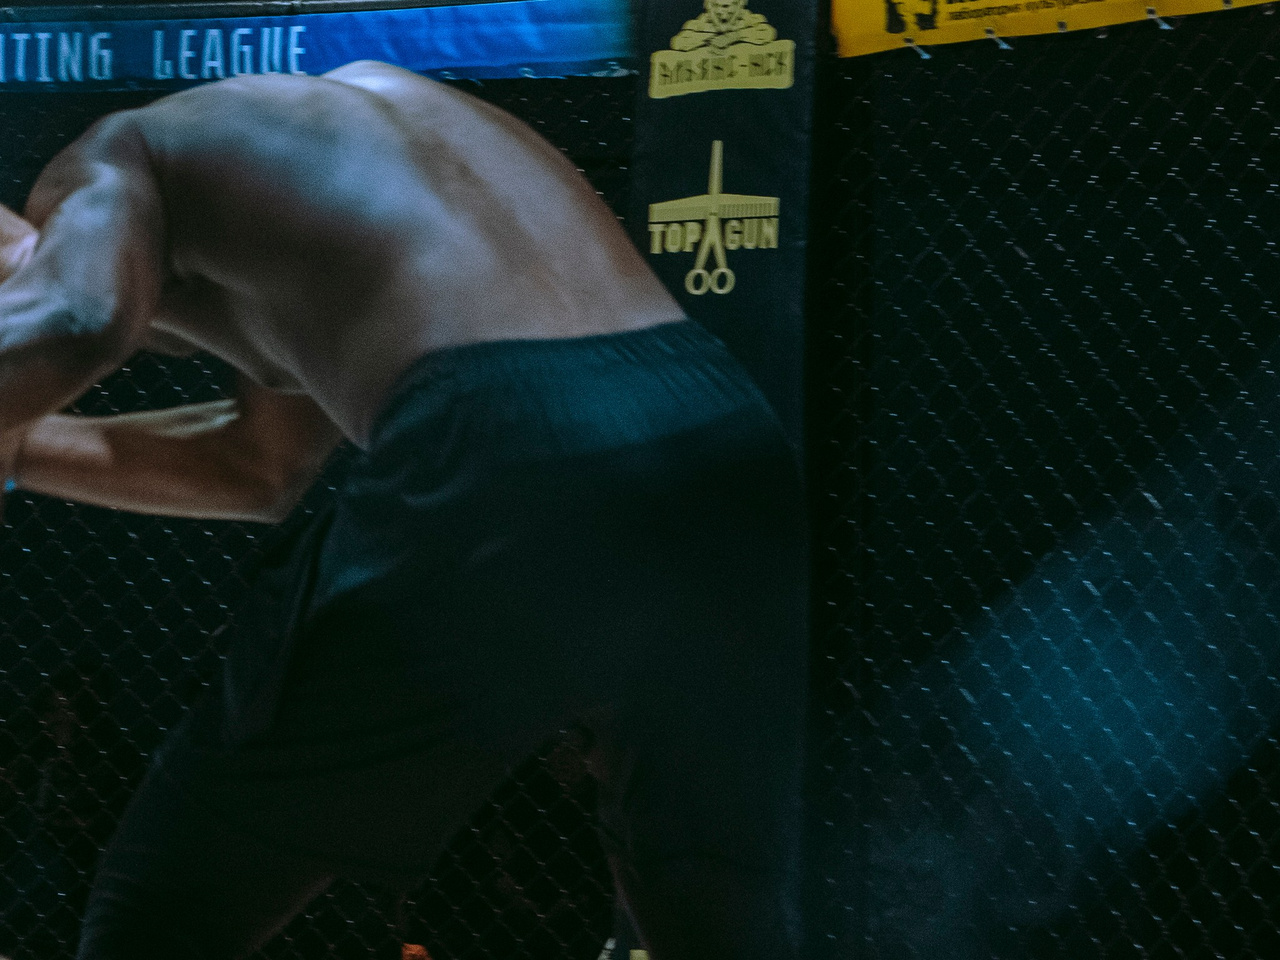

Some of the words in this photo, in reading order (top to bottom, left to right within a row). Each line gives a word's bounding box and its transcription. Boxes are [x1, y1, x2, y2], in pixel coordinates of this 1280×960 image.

[152, 24, 308, 80] LEAGUE
[648, 222, 702, 254] TOP
[724, 217, 780, 251] GUN
